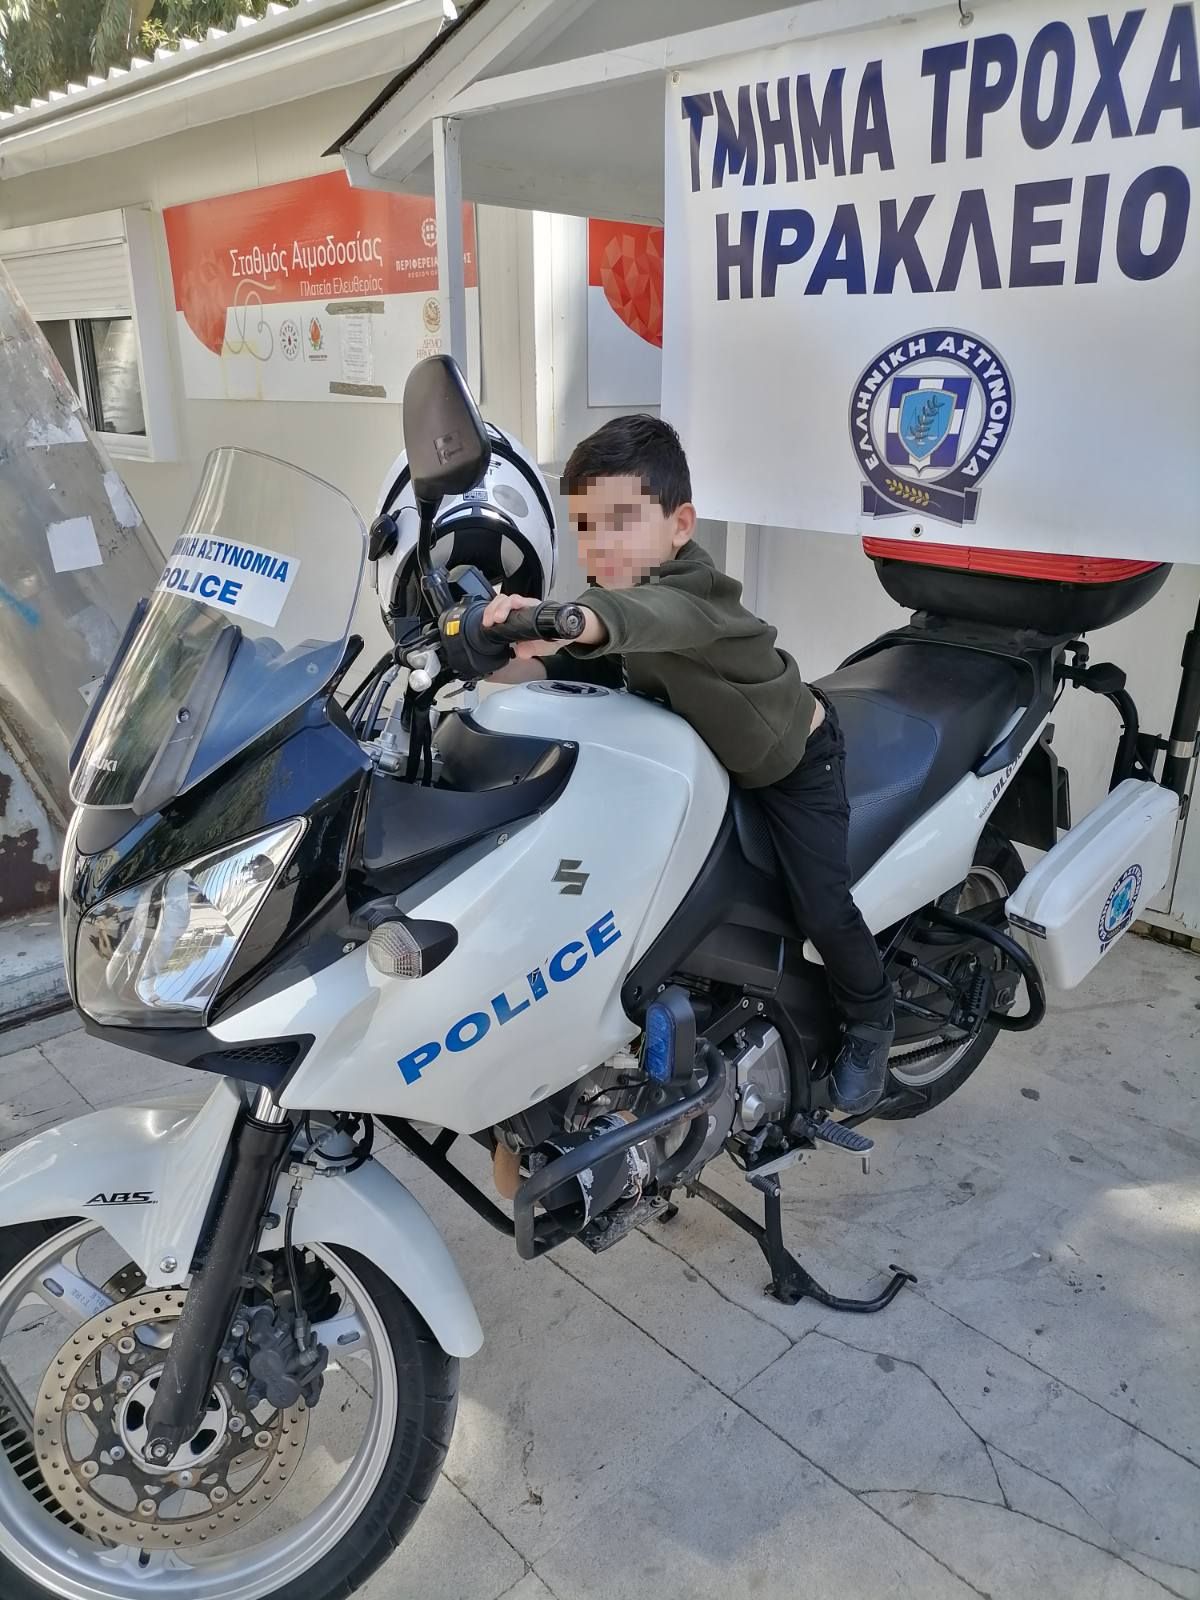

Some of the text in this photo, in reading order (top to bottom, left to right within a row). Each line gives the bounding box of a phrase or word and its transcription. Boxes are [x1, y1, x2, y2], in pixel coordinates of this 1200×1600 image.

[681, 2, 1200, 192] ΤΜΗΜΑ ΤΡΟΧΑ
[230, 231, 383, 280] Σταθμός Αιμοδοσίας
[715, 165, 1191, 300] ΗΡΑΚΛΕΙΟ
[300, 274, 383, 297] Πλατεία Ελευθερίας
[856, 336, 1008, 477] ΕΛΛΗΝΙΚΗ ΑΣΤΥΝΟΜΙΑ
[197, 539, 289, 583] ΑΣΤΥΝΟΜΙΑ
[160, 568, 243, 605] POLICE
[397, 910, 622, 1086] POLICE
[85, 1191, 155, 1205] ABS
